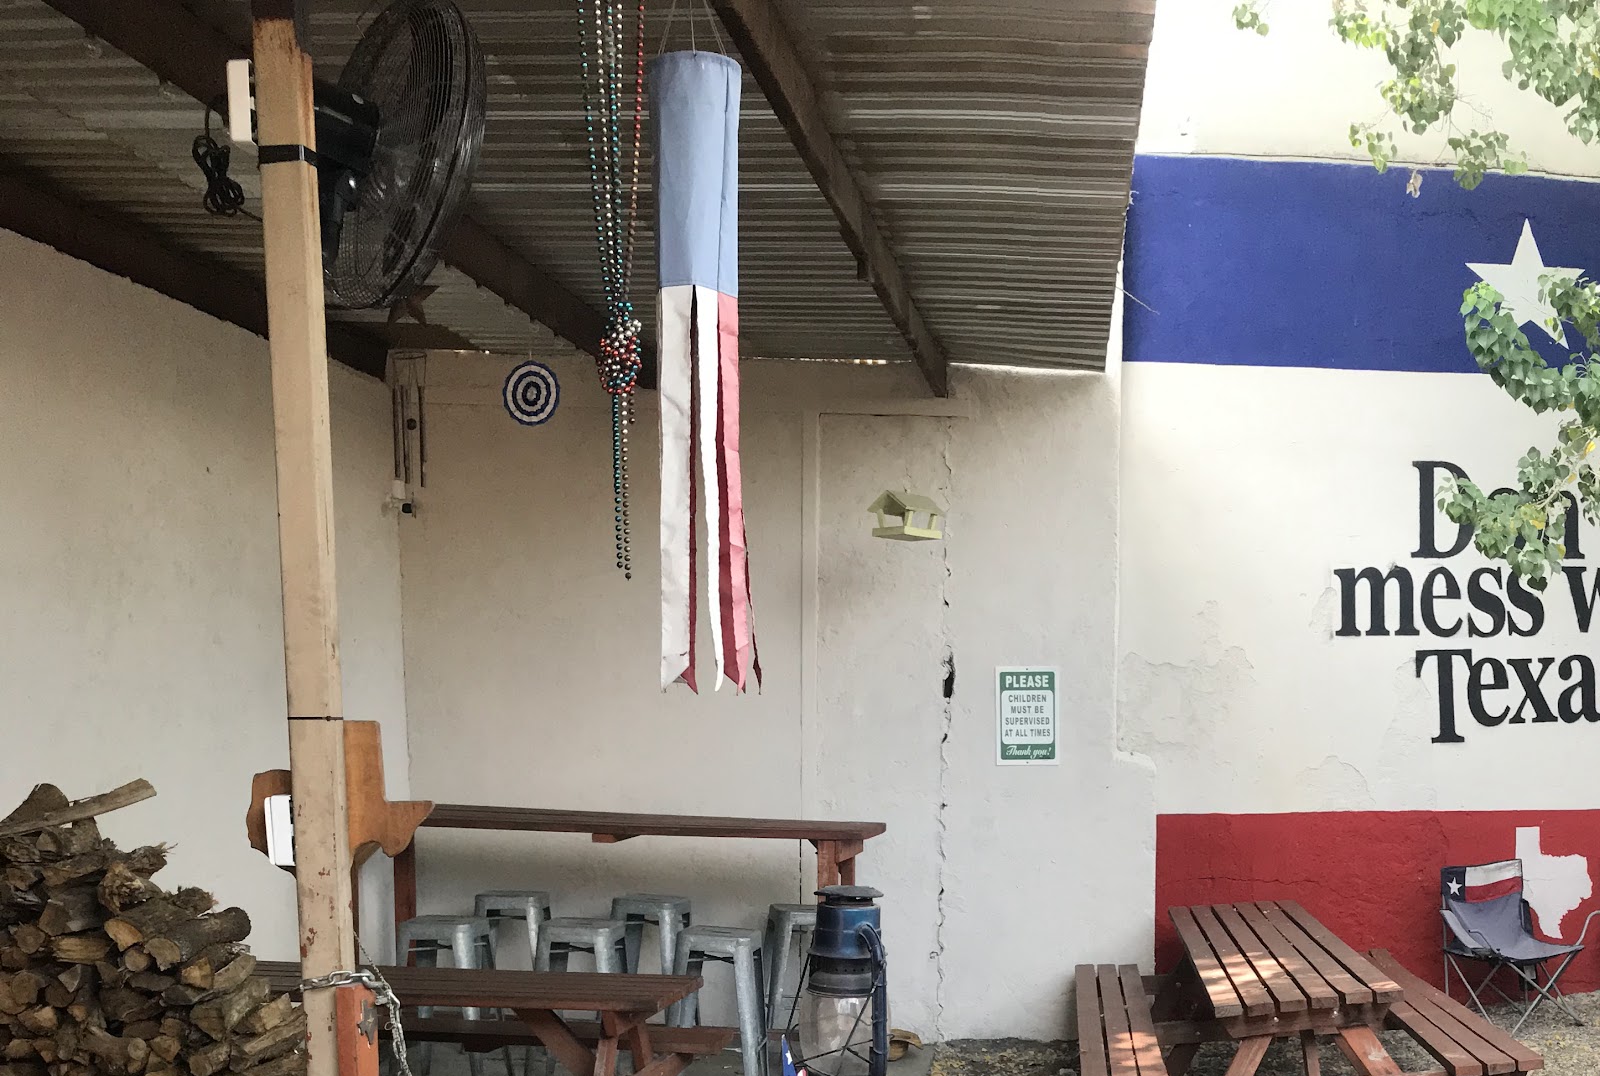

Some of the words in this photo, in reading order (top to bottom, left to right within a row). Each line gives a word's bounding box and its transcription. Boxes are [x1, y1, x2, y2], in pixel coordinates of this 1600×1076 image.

[1333, 564, 1545, 638] mess
[1005, 675, 1050, 688] PLEASE
[1008, 694, 1047, 703] CHILDREN
[1010, 705, 1031, 714] MUST
[1034, 705, 1045, 714] BE
[1005, 717, 1050, 726] SUPERVISED
[1004, 729, 1013, 737] AT
[1015, 729, 1028, 737] ALL
[1030, 728, 1051, 737] TIMES
[1006, 745, 1031, 756] Thank
[1030, 746, 1052, 760] you!
